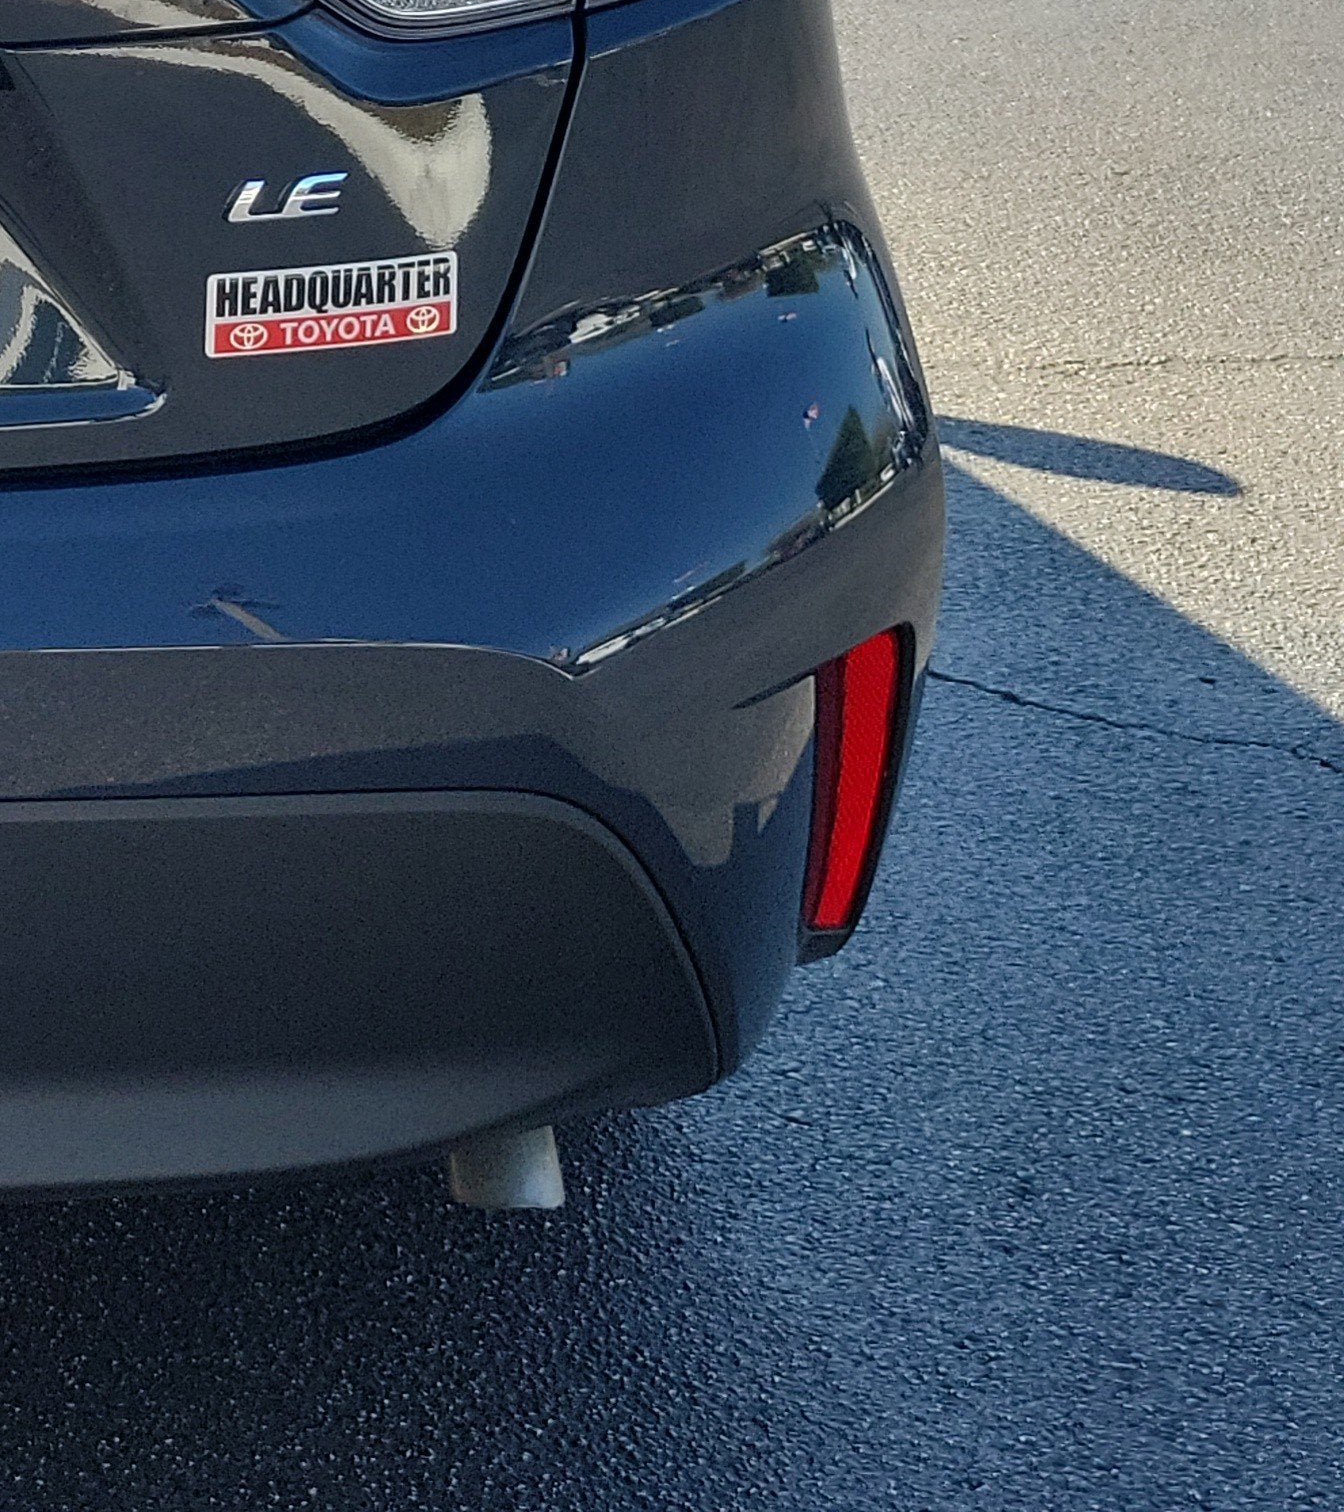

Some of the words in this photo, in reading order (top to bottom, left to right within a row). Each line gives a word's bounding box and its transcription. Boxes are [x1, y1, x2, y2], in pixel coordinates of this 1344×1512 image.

[224, 171, 349, 223] LE
[215, 256, 452, 318] HEADQUARTER
[280, 313, 396, 345] TOYOTA
